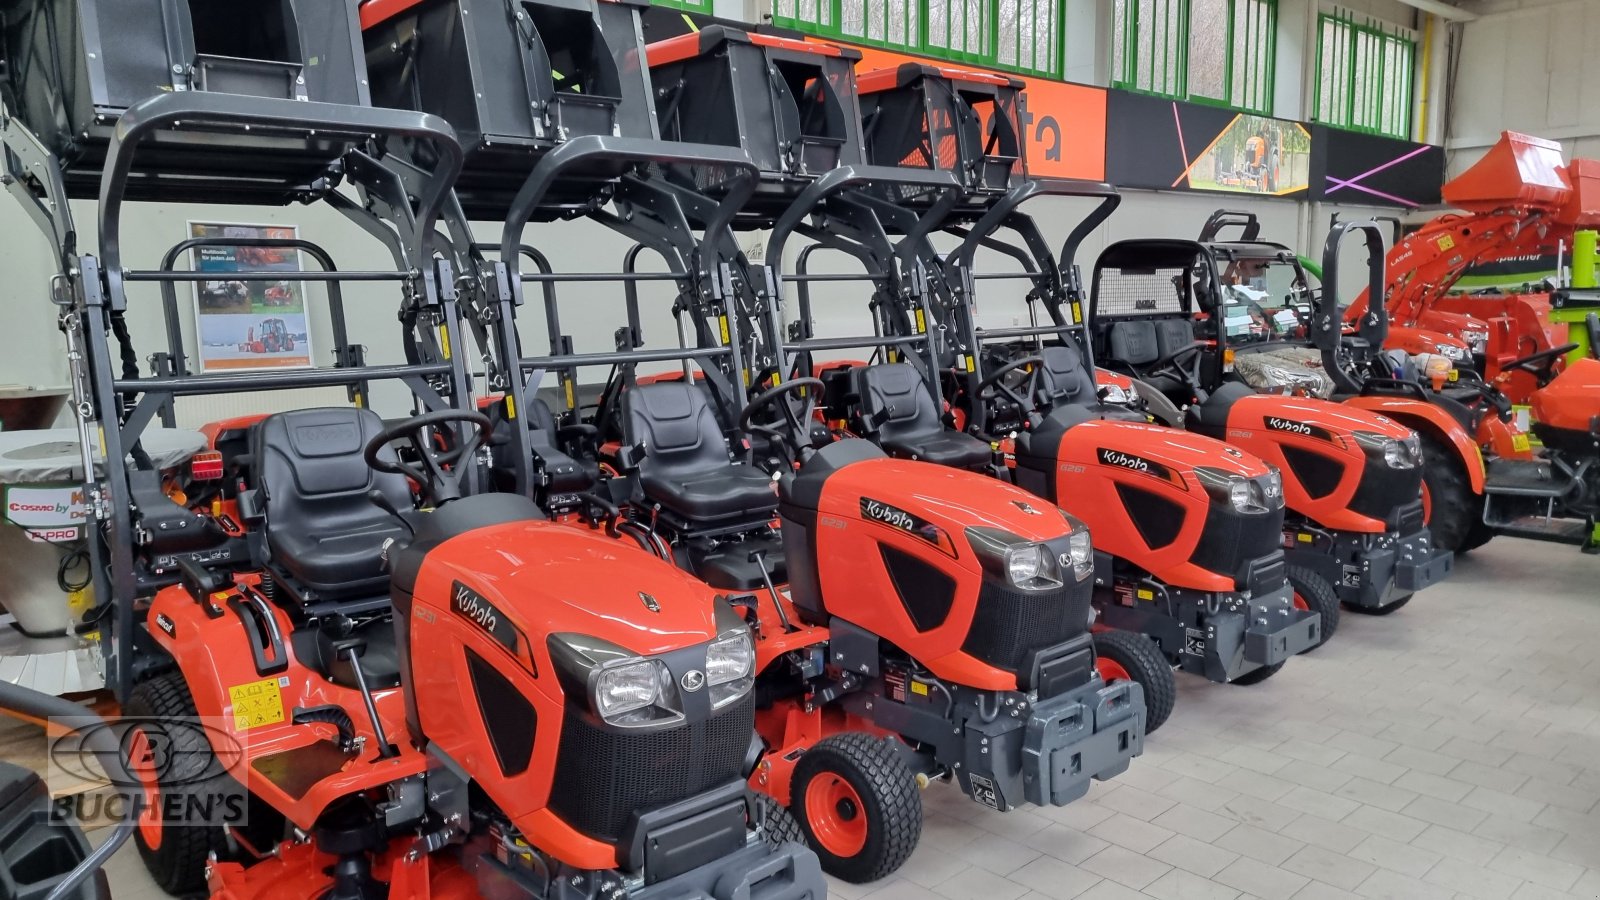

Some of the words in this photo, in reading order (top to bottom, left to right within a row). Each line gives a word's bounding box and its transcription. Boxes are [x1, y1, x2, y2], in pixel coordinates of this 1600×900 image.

[1270, 417, 1311, 435] Kubota
[1103, 450, 1148, 472] Kubota
[55, 503, 70, 514] by
[866, 500, 914, 531] Kubota
[456, 586, 497, 632] Kubota
